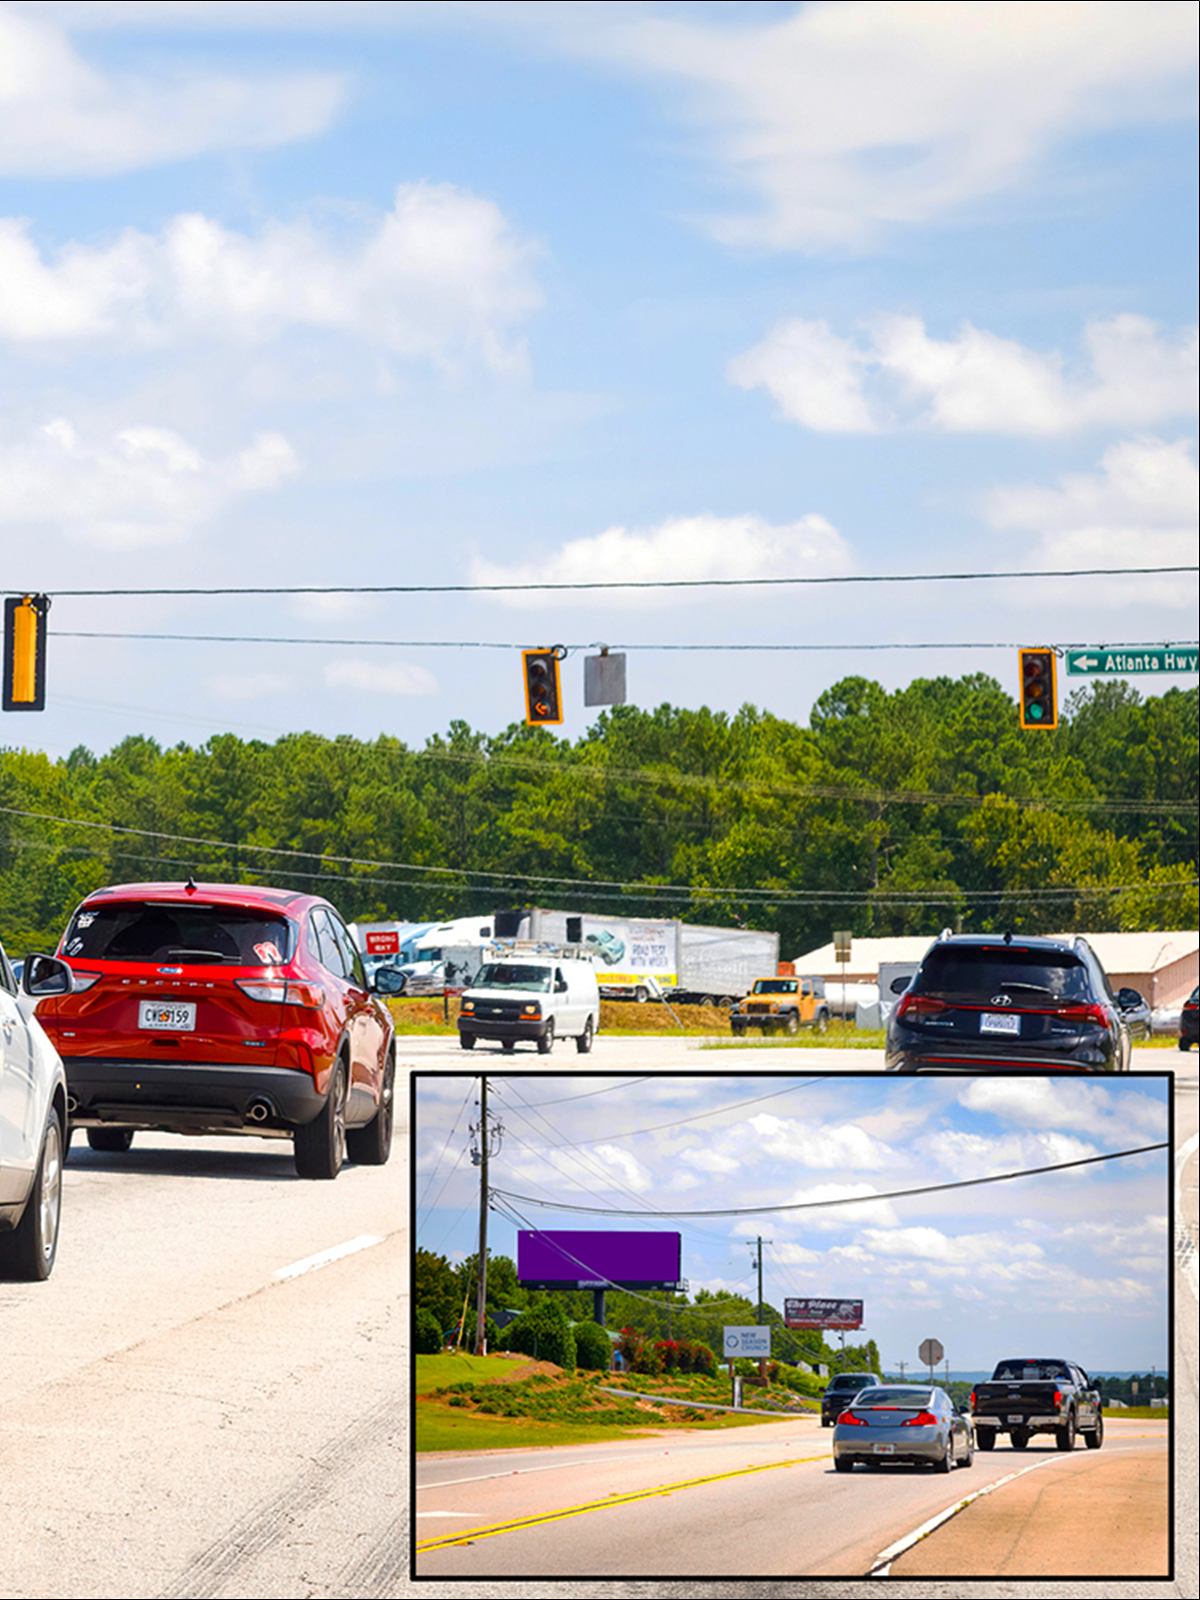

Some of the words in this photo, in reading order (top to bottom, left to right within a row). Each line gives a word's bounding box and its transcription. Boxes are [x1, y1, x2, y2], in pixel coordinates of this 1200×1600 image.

[1105, 654, 1159, 671] Atlanta
[1165, 653, 1198, 672] Hwy
[369, 934, 397, 944] WRONG
[374, 944, 392, 952] WAY
[786, 1300, 805, 1309] The
[808, 1300, 838, 1310] Place
